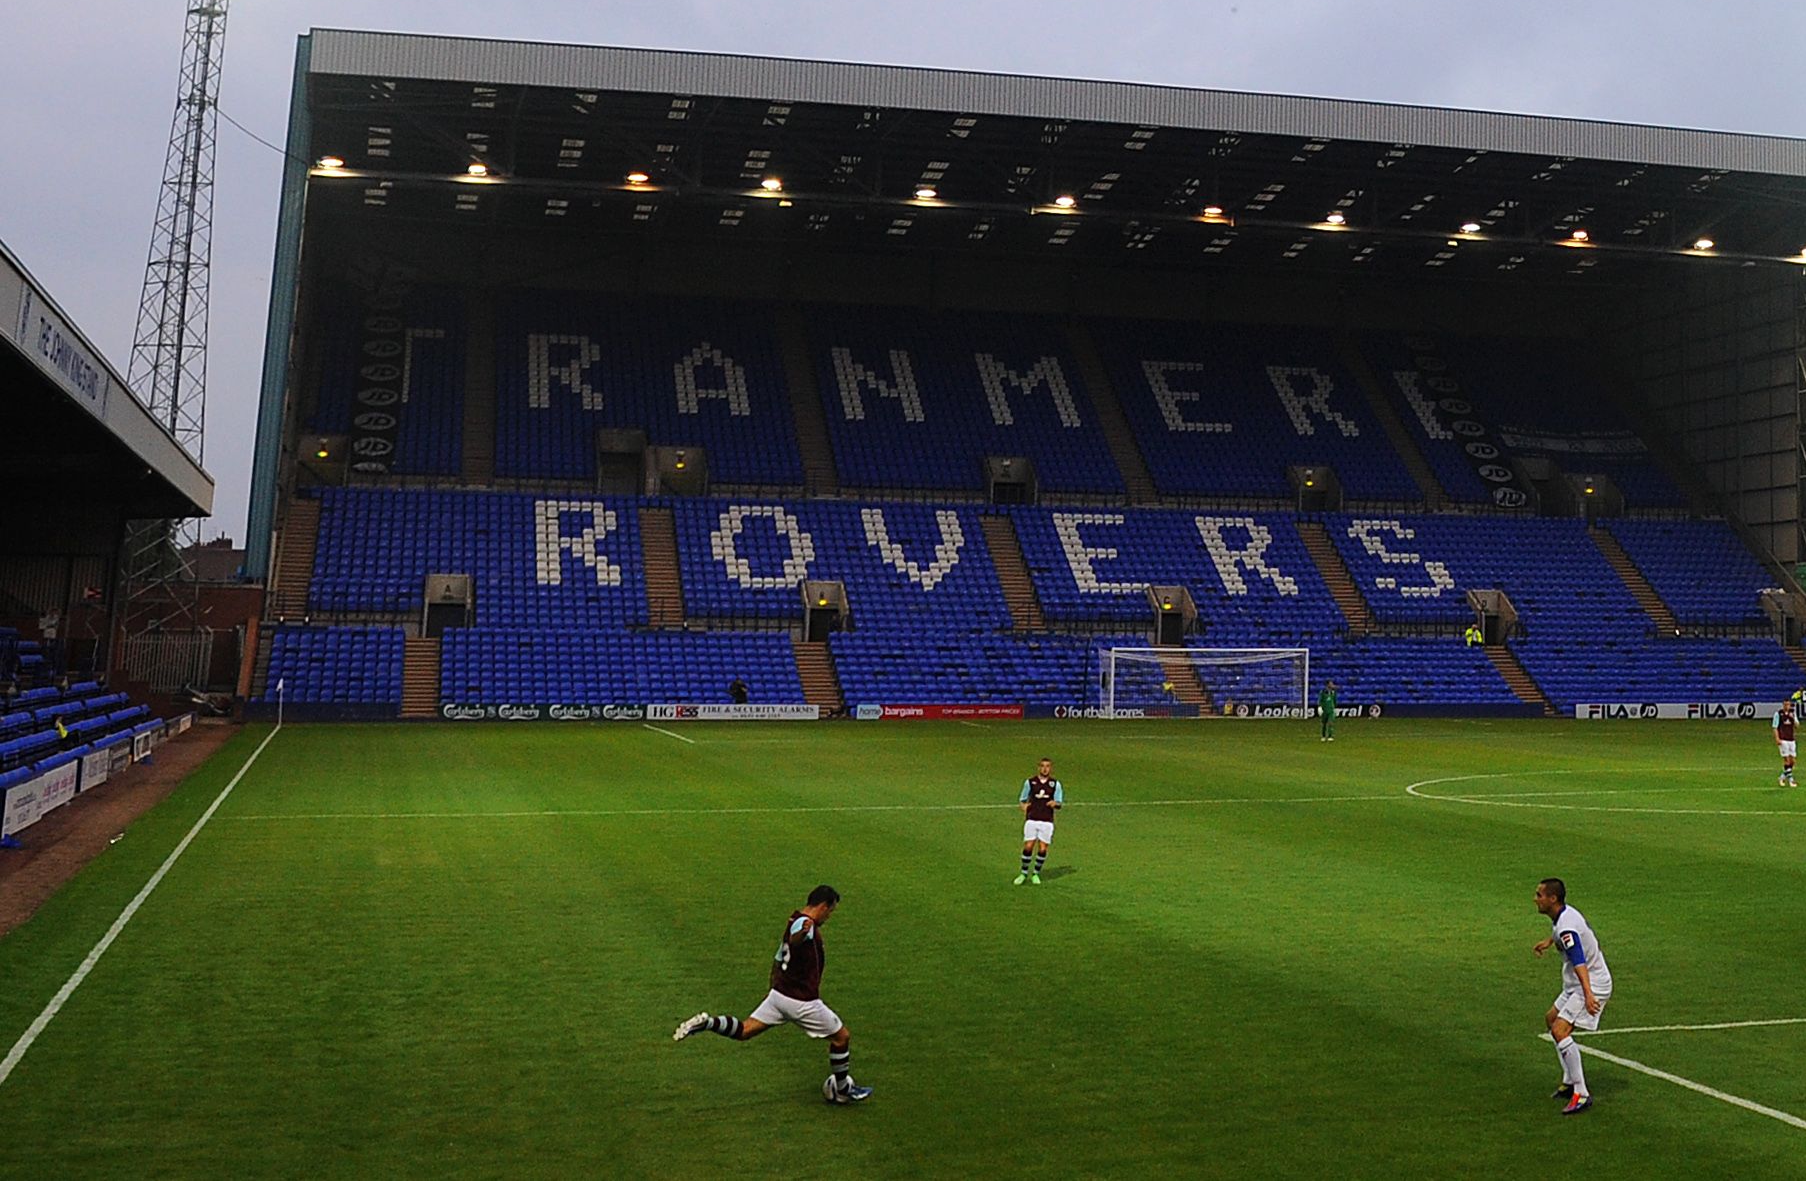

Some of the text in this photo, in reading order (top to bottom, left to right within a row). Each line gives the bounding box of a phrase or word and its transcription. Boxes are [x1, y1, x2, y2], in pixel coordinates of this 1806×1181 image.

[534, 499, 1456, 598] ROVERS
[443, 703, 485, 720] Carlsberg
[498, 703, 540, 720] Carlsberg
[549, 703, 590, 720] Carlsberg
[602, 703, 643, 720] Carlsberg
[859, 706, 924, 717] home bargains
[1589, 704, 1628, 719] FILA
[1641, 705, 1657, 717] JD
[1687, 704, 1727, 718] FILA
[1739, 705, 1754, 717] JD
